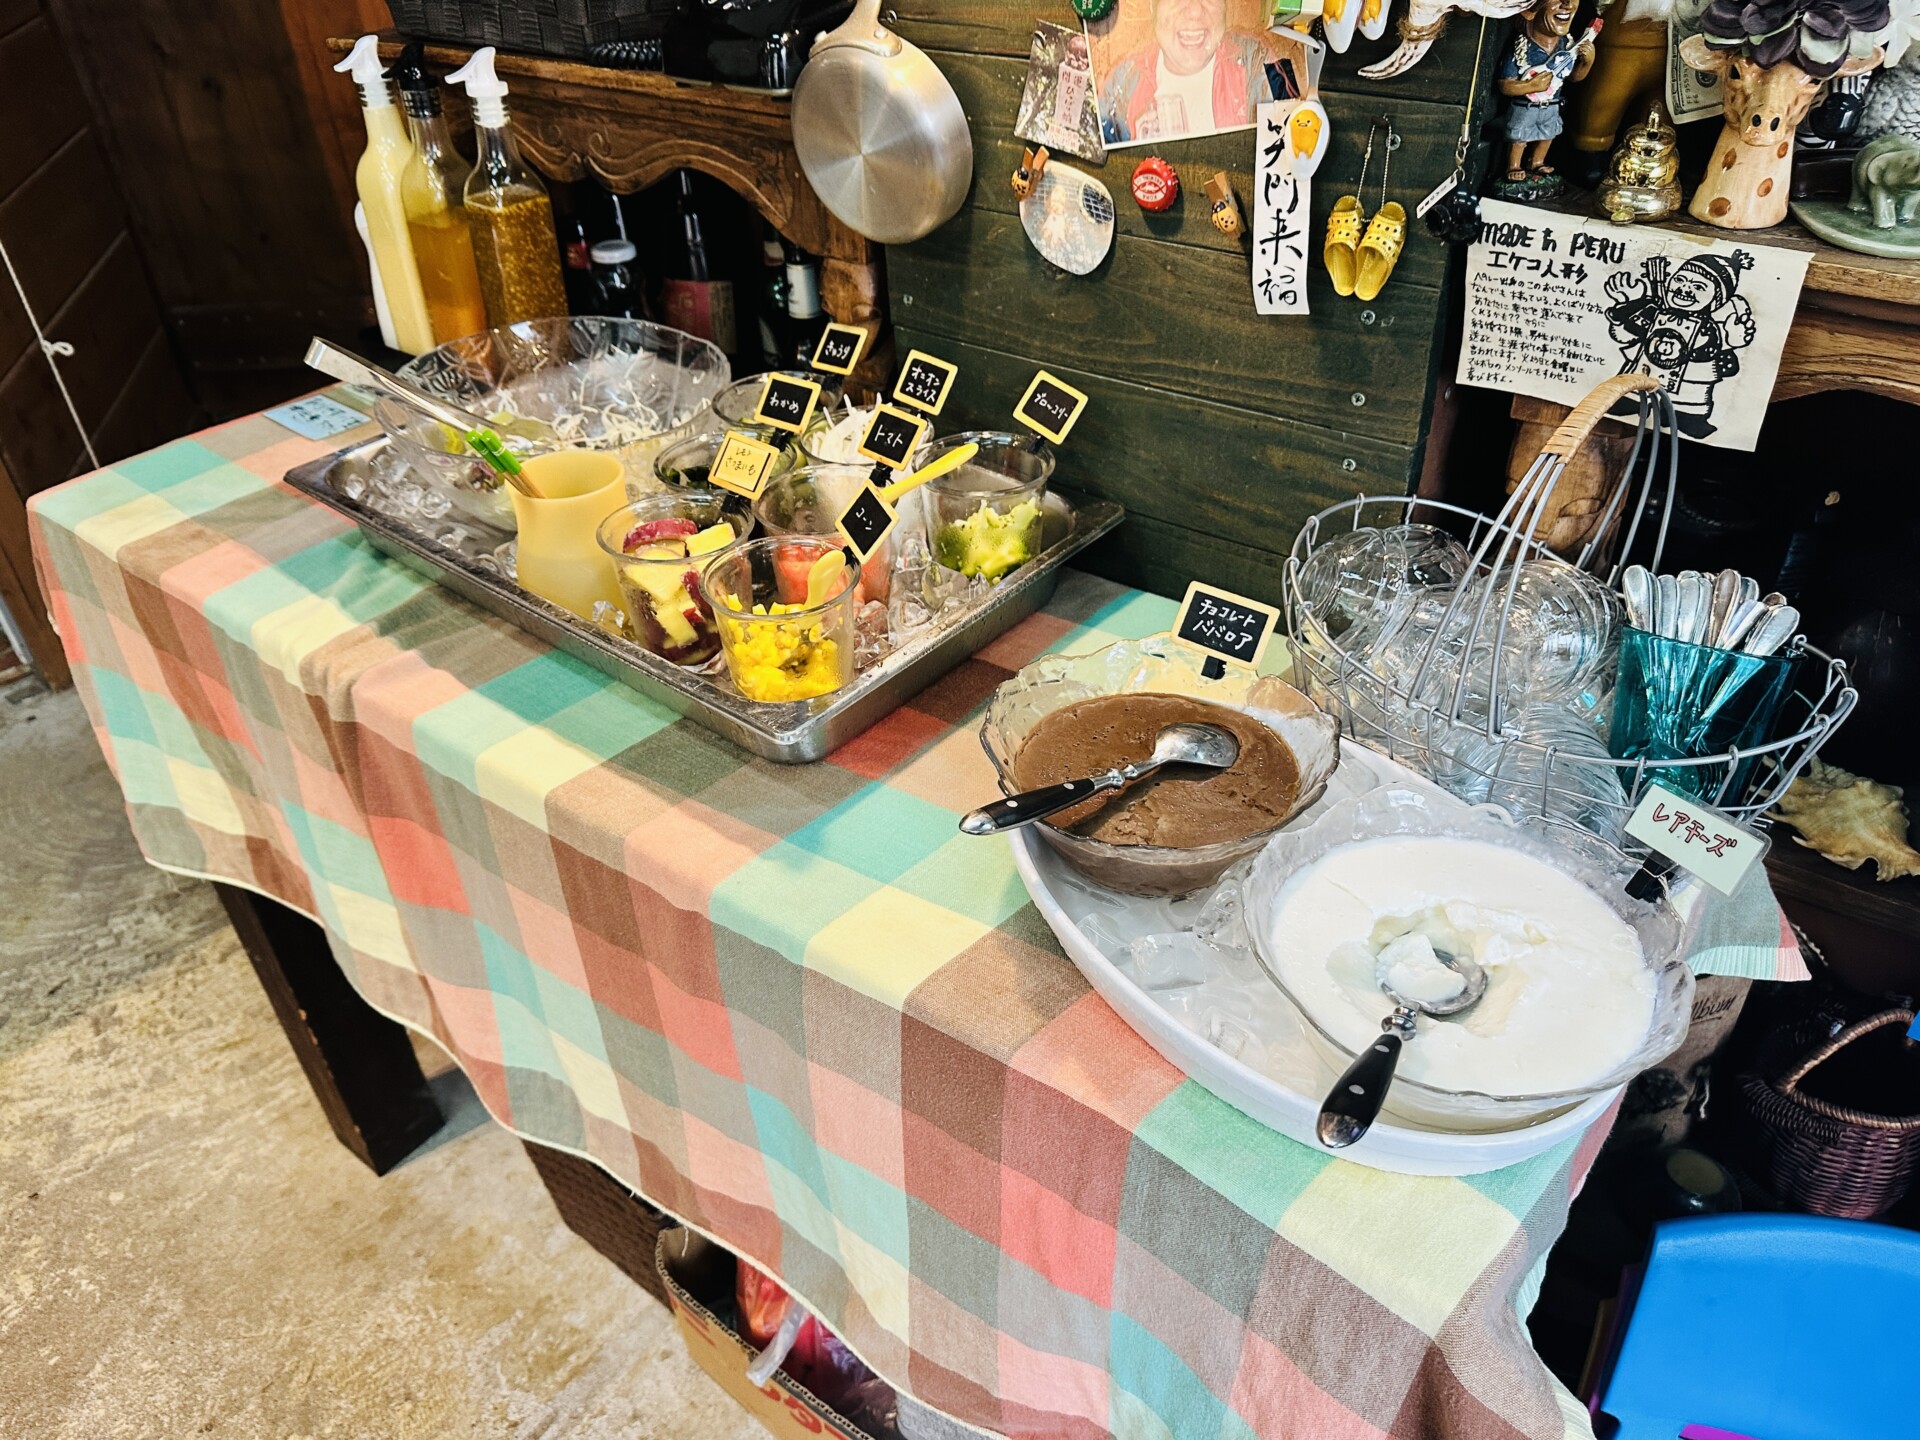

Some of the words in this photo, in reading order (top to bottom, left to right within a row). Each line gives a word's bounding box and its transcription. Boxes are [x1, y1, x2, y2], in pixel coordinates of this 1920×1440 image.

[1569, 232, 1626, 264] PERU
[1486, 250, 1588, 285] エケコ人形
[911, 364, 941, 387] オニオン
[769, 391, 799, 414] わかめ
[905, 382, 937, 403] スライス
[1034, 392, 1069, 420] ブロッコリー
[874, 424, 904, 448] トマト
[725, 455, 757, 476] さつまいも
[855, 506, 873, 531] コーン
[1198, 598, 1256, 627] チョコレート
[1192, 619, 1253, 651] ババロア
[1651, 802, 1738, 858] レアチーズ
